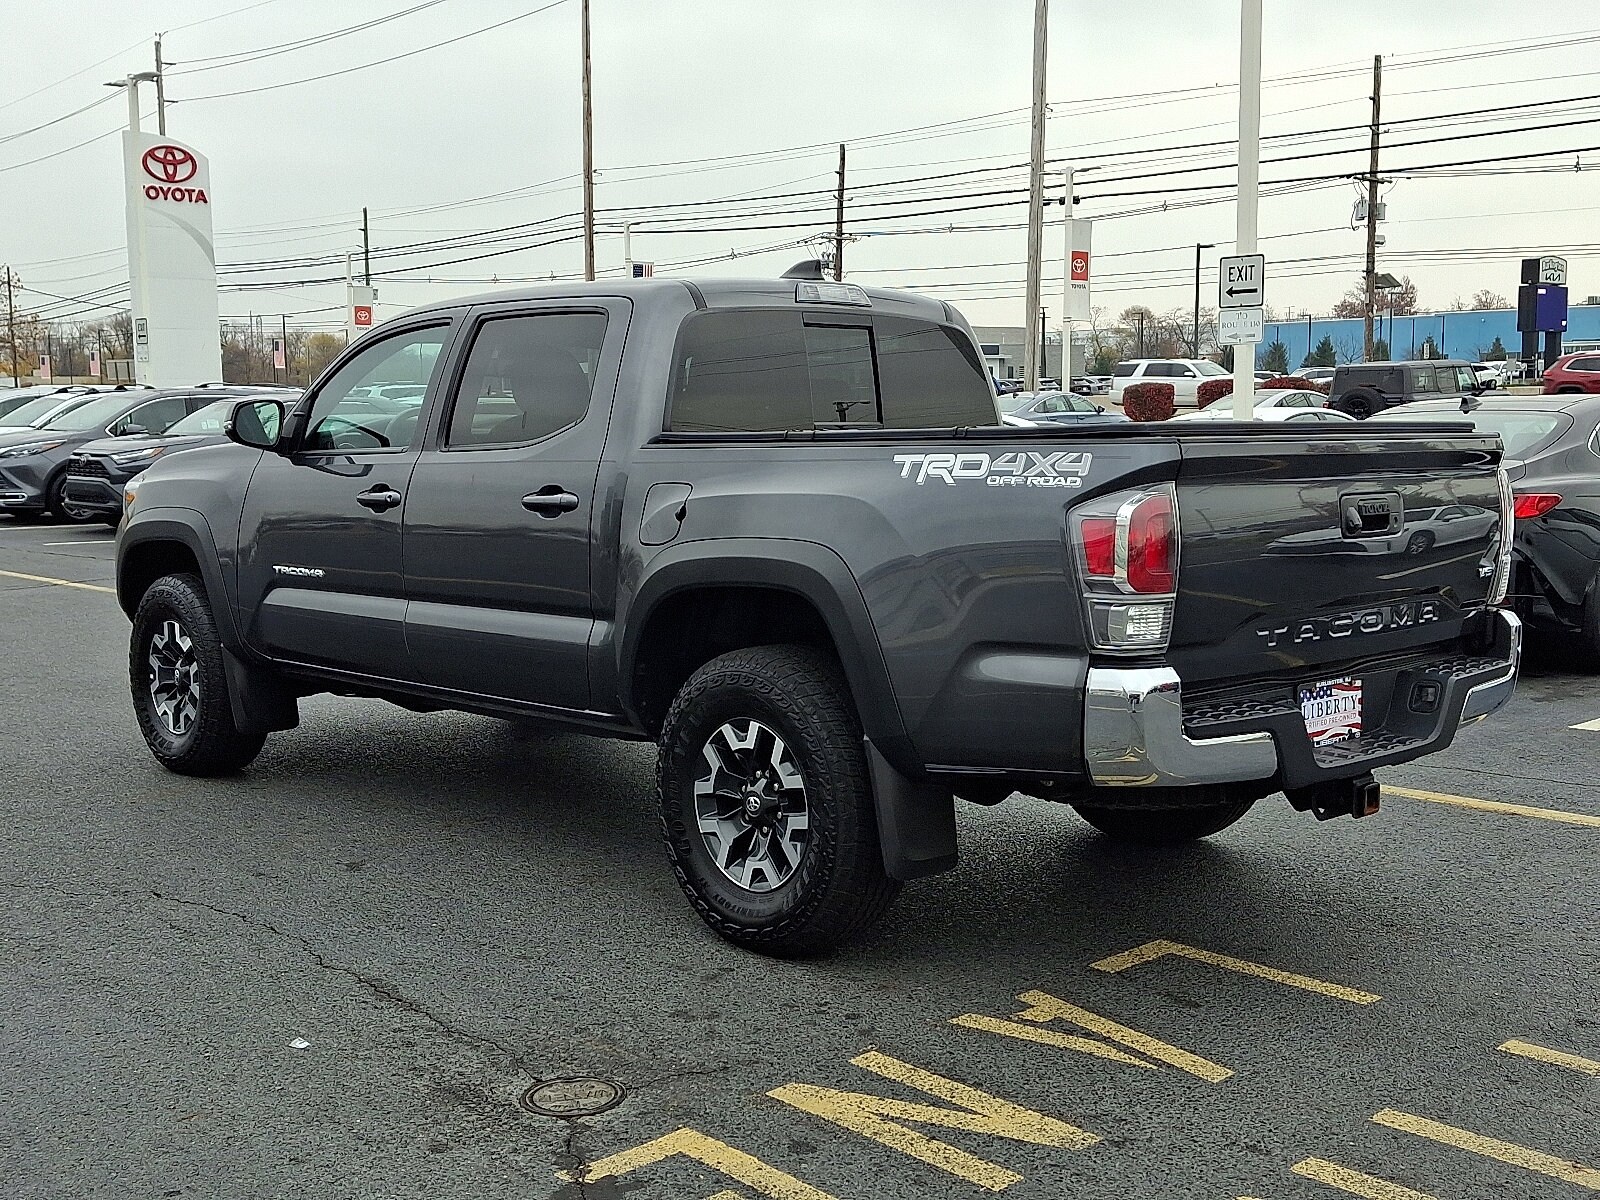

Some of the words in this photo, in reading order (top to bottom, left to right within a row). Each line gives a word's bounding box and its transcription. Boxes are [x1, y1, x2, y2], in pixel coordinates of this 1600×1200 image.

[143, 185, 208, 204] OYOTA
[1228, 264, 1256, 283] EXIT
[1222, 321, 1248, 329] ROUE
[892, 452, 991, 486] TRD
[272, 564, 326, 578] TACOMA
[1256, 600, 1440, 647] TACOMA
[1302, 694, 1358, 721] LIBERTY
